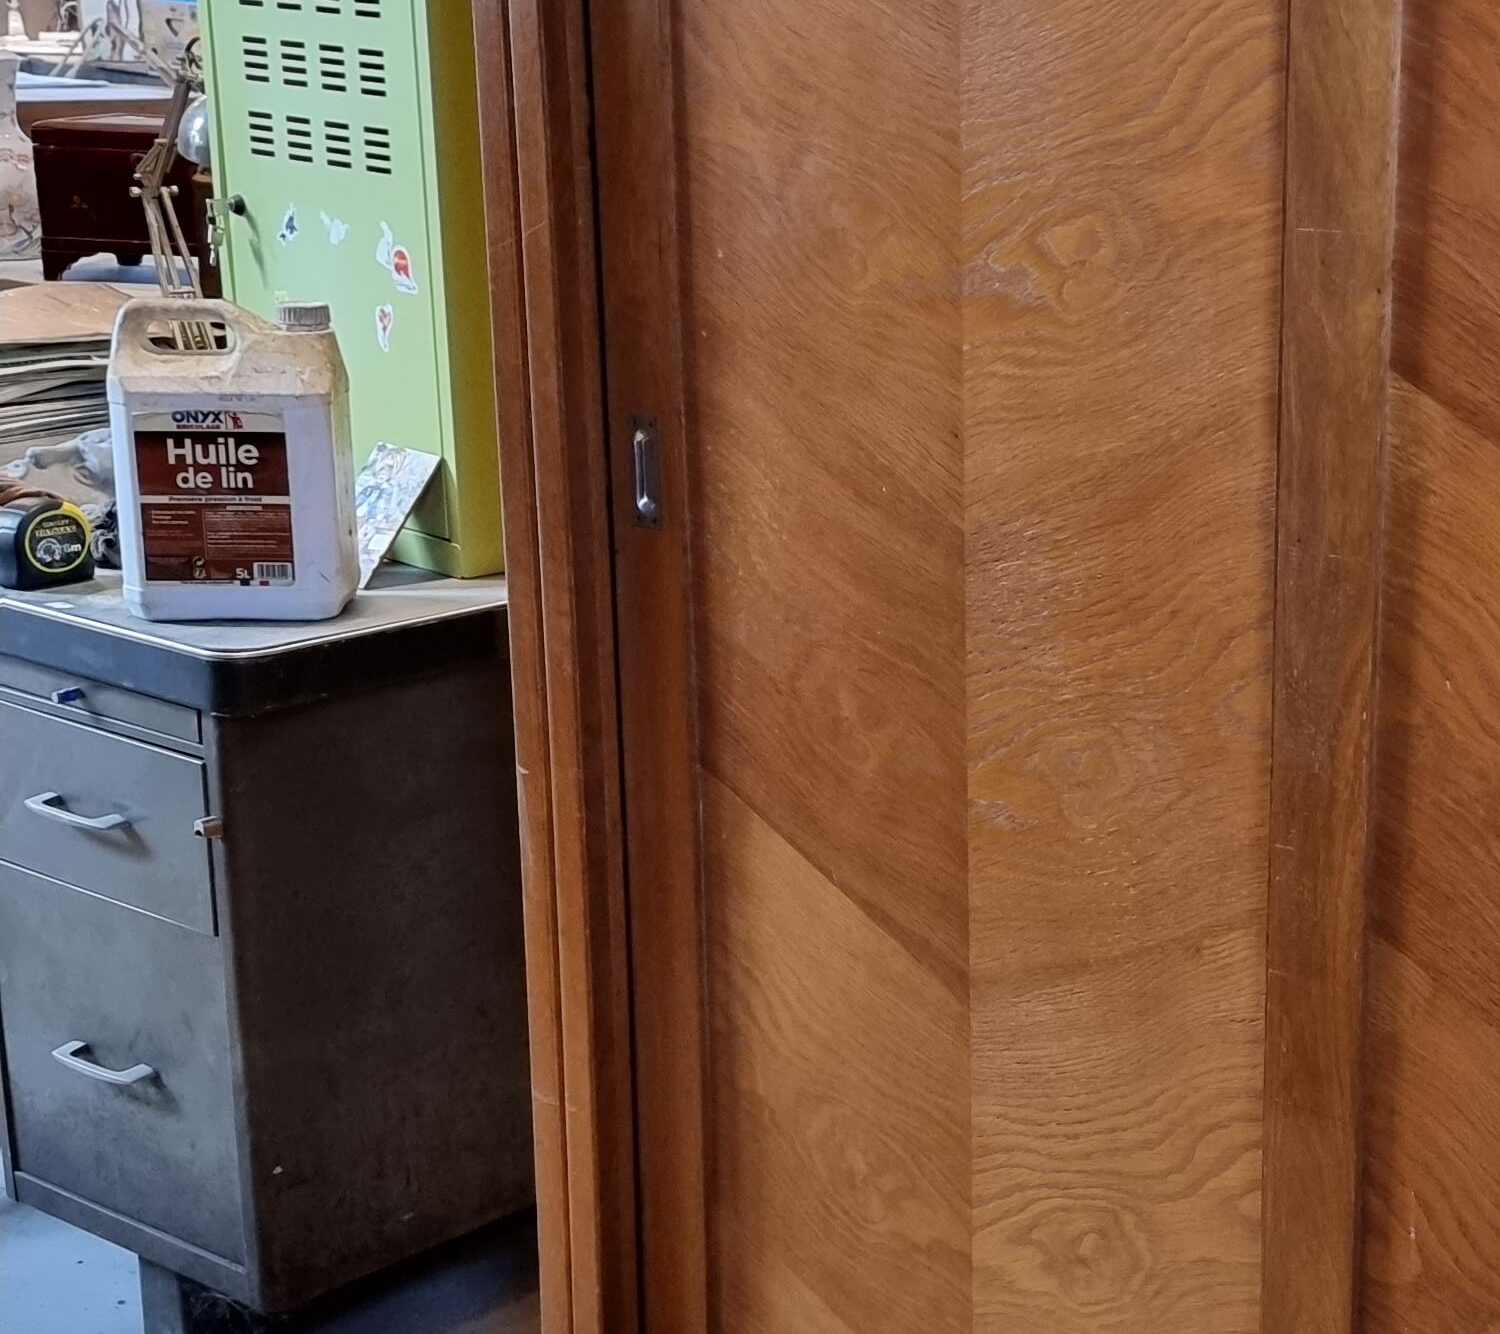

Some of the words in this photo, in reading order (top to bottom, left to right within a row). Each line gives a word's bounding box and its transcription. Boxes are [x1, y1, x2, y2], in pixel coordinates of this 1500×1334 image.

[171, 411, 223, 424] ONYX
[166, 437, 260, 465] Huile
[176, 466, 214, 489] de
[220, 467, 254, 489] lin
[236, 568, 250, 579] 5L
